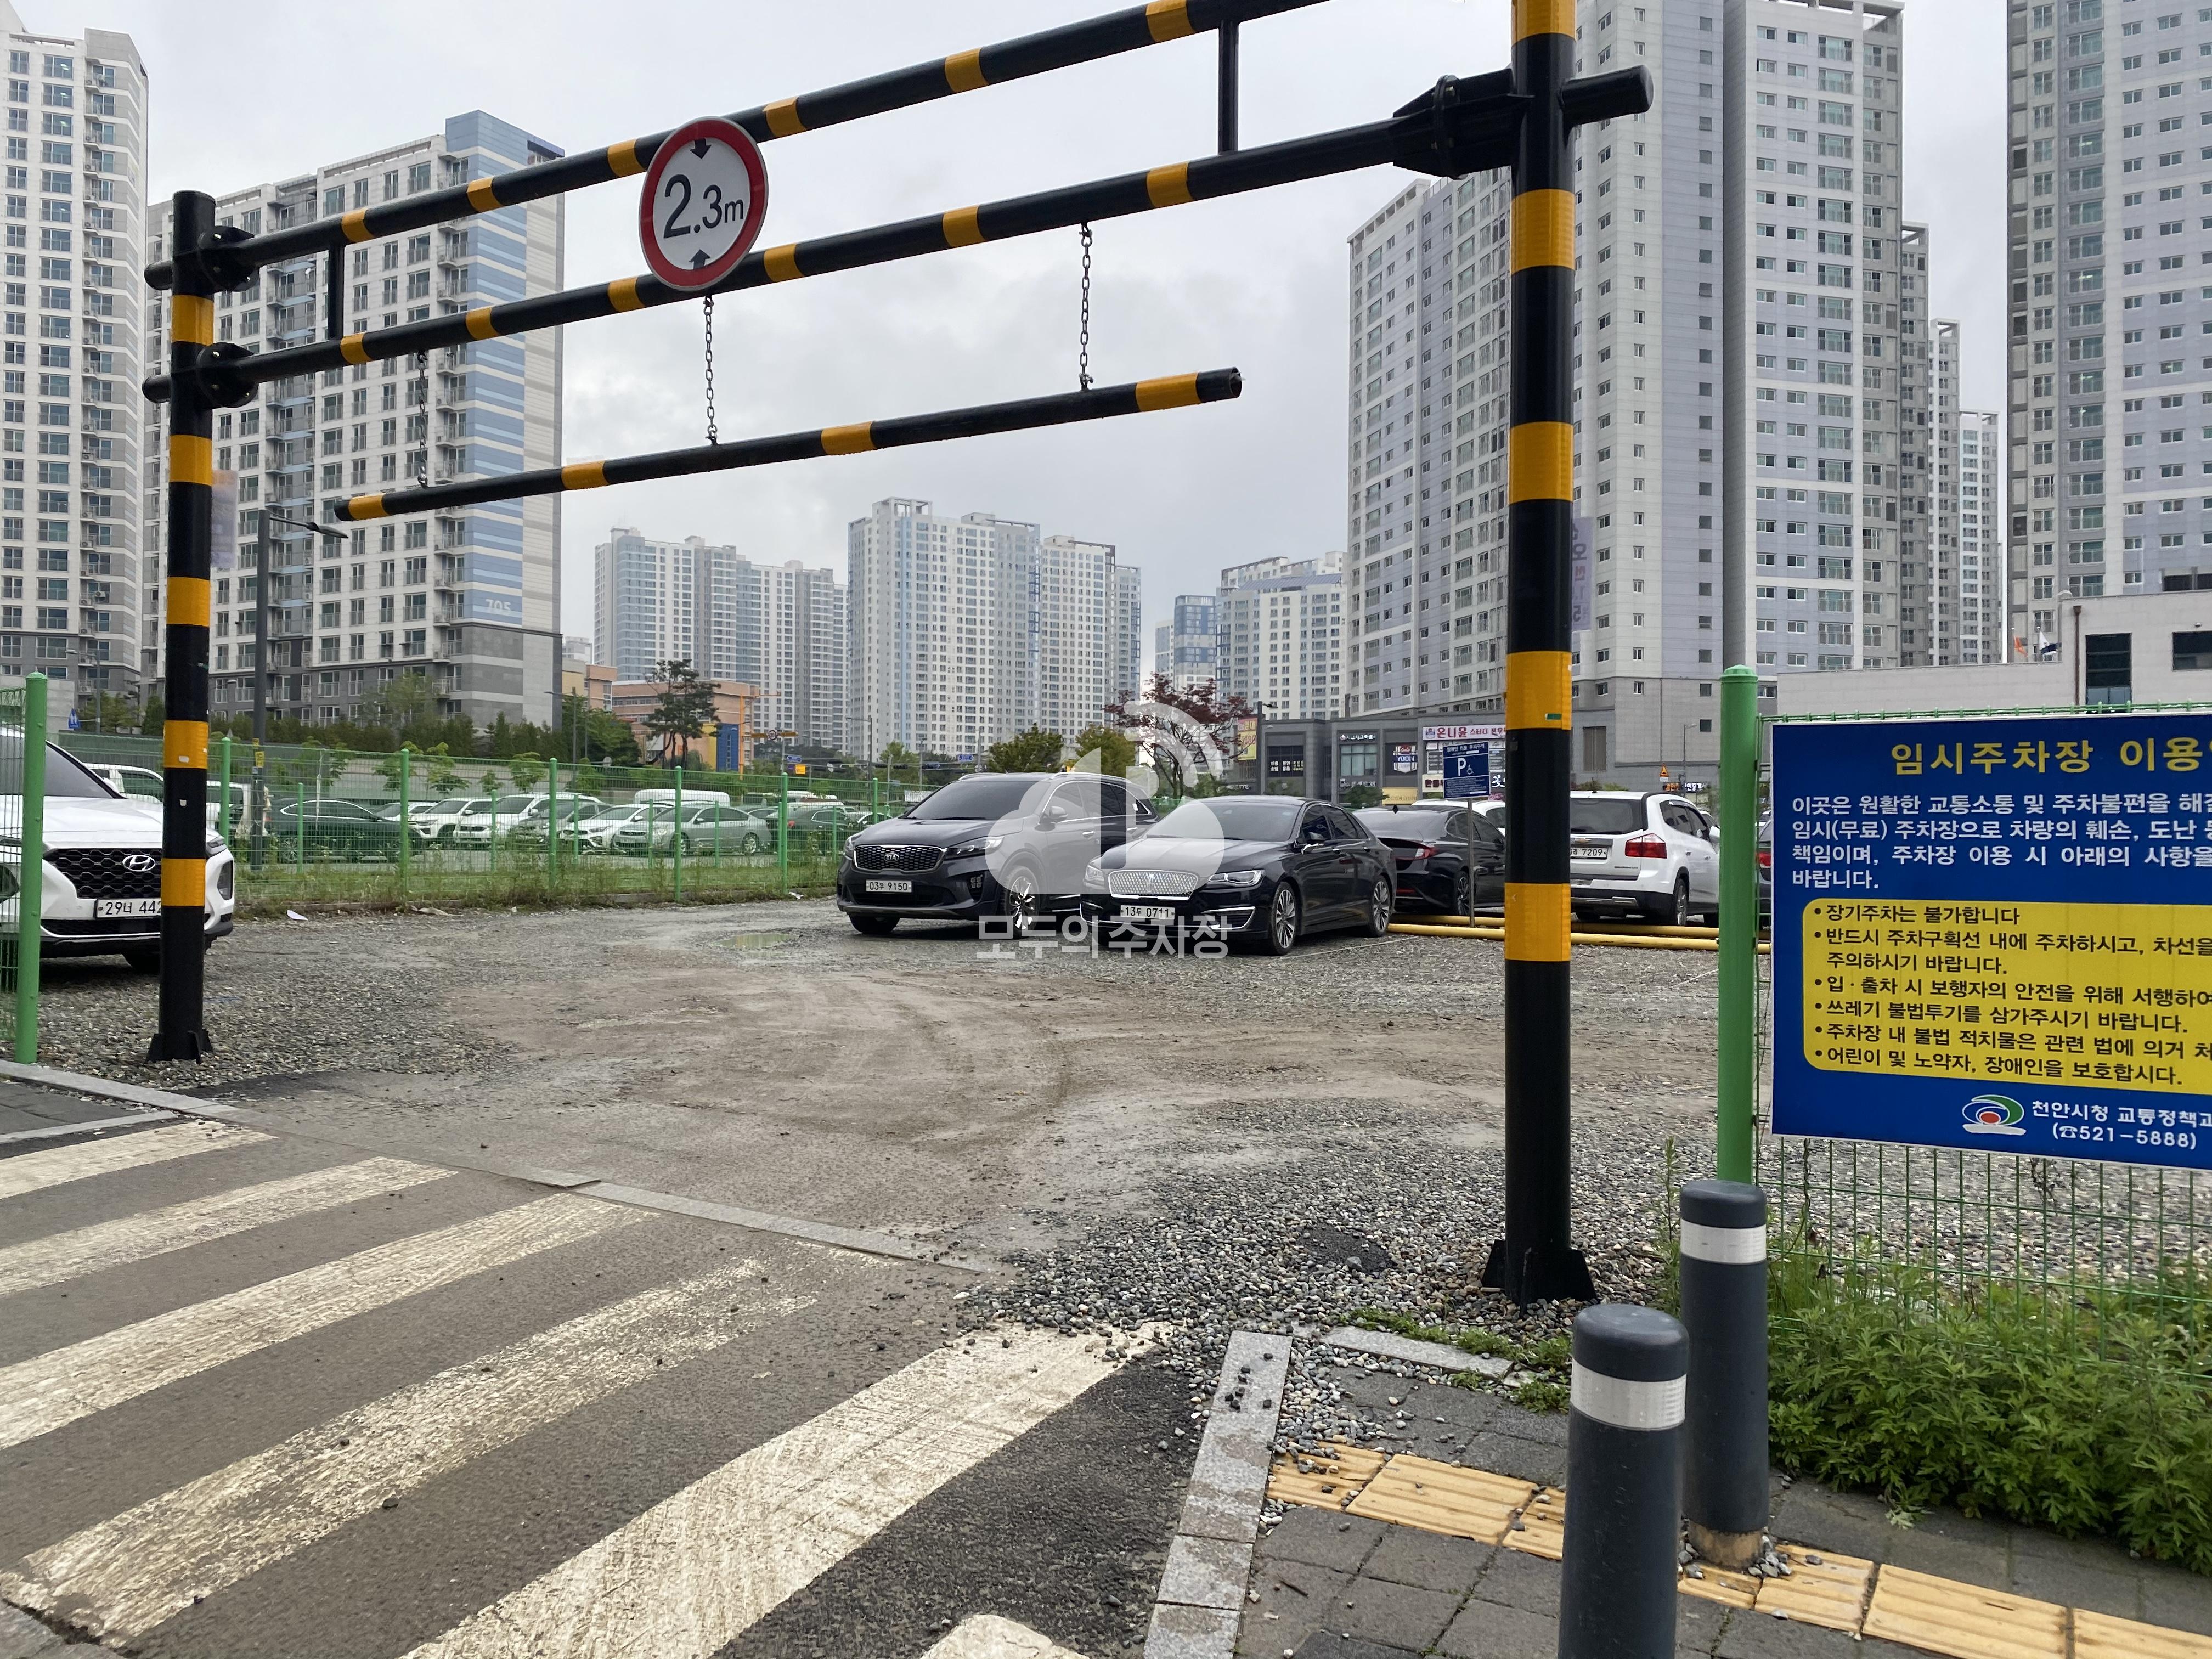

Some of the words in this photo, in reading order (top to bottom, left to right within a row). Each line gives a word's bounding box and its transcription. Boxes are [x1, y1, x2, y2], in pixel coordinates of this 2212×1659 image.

[663, 174, 744, 239] 2.3m
[486, 599, 512, 614] 705
[1458, 758, 1466, 776] P
[1892, 741, 2093, 774] 임시주차장
[2121, 738, 2212, 771] 이용
[1491, 774, 1505, 788] 꽃
[1793, 797, 1851, 815] 이곳은
[1859, 795, 1921, 814] 원활한
[1928, 795, 2015, 814] 교통소통
[2024, 795, 2044, 814] 및
[2053, 793, 2170, 814] 주차불편을
[1793, 820, 1887, 840] 임시(무료)
[1895, 821, 2002, 839] 주차장으로
[2010, 820, 2076, 839] 차량의
[2086, 820, 2138, 841] 훼손,
[2149, 820, 2197, 839] 도난
[1793, 845, 1878, 865] 책임이며,
[1892, 846, 1956, 865] 주차장
[1970, 846, 2012, 865] 이용
[2025, 847, 2045, 865] 시
[2062, 847, 2129, 866] 아래의
[2145, 847, 2212, 867] 사항을
[888, 882, 908, 891] 9150
[1793, 870, 1878, 888] 바랍니다.
[1146, 907, 1169, 918] 0711
[1827, 905, 1916, 922] 장기주차는
[1924, 907, 2020, 924] 불가합니다
[1827, 928, 1878, 945] 반드시
[1887, 930, 1980, 948] 주차구획선
[1990, 933, 2027, 950] 내에
[2036, 934, 2143, 955] 주차하시고,
[2154, 938, 2212, 956] 차선을
[1827, 952, 1916, 971] 주의하시기
[1926, 956, 2006, 974] 바랍니다.
[1905, 979, 1921, 995] 시
[1930, 980, 2006, 999] 보행자의
[2015, 984, 2074, 1002] 안전을
[2084, 986, 2123, 1005] 위해
[1827, 1001, 1879, 1018] 쓰레기
[1888, 1002, 1982, 1023] 불법투기를
[1990, 1007, 2088, 1029] 삼가주시기
[2099, 1012, 2187, 1032] 바랍니다.
[1827, 1024, 1881, 1042] 주차장
[1889, 1027, 1905, 1043] 내
[1914, 1028, 1949, 1046] 불법
[1960, 1030, 2036, 1050] 적치물은
[2045, 1035, 2084, 1053] 관련
[2095, 1038, 2133, 1056] 법에
[2144, 1041, 2183, 1059] 의거
[1828, 1047, 1880, 1066] 어린이
[1889, 1051, 1905, 1067] 및
[1914, 1053, 1976, 1073] 노약자,
[1985, 1057, 2063, 1077] 장애인을
[2072, 1062, 2181, 1085] 보호합시다.
[2033, 1101, 2108, 1121] 천안시청
